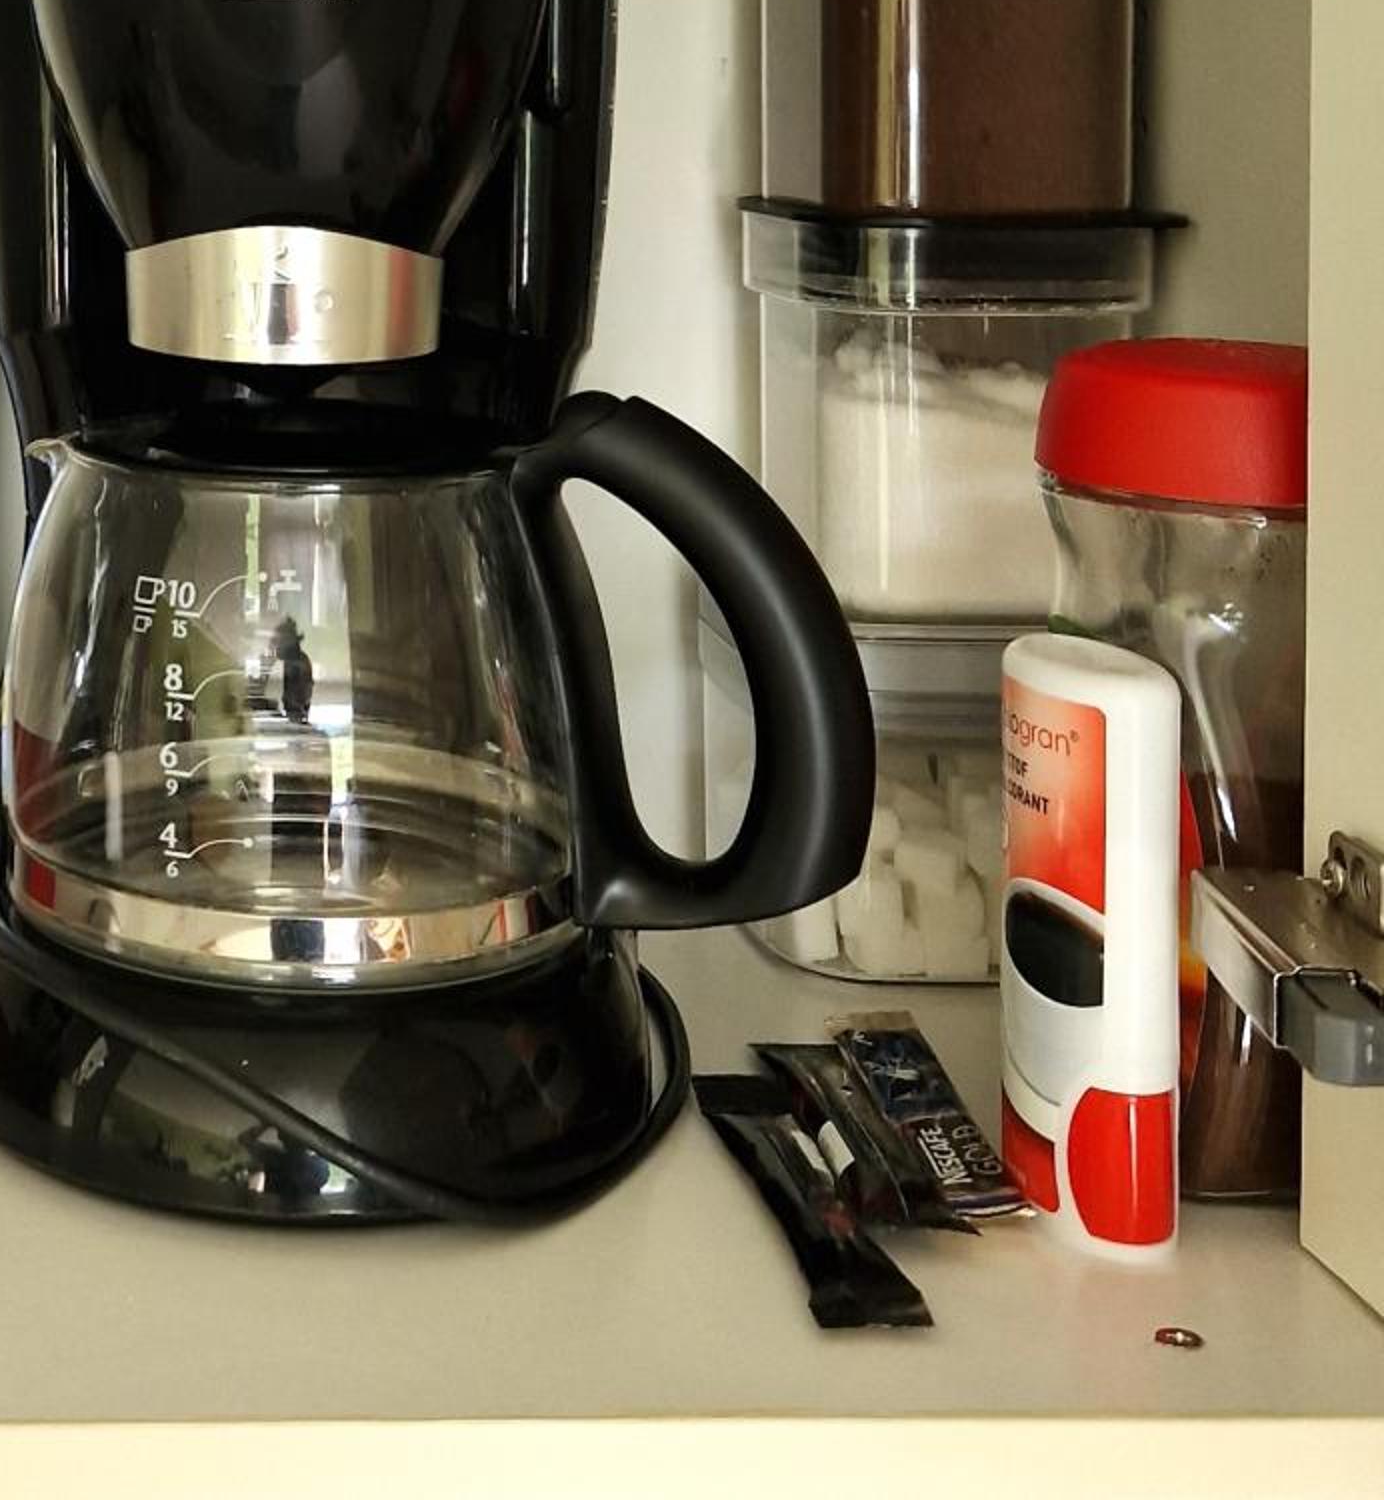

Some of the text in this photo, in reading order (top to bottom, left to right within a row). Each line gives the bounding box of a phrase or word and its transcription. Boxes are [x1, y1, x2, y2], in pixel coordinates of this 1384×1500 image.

[168, 579, 196, 609] 10
[171, 619, 188, 638] 15
[164, 663, 183, 691] 8
[165, 701, 183, 721] 12
[159, 742, 179, 768] 6
[166, 779, 179, 797] 9
[159, 822, 178, 850] 4
[166, 860, 180, 878] 6
